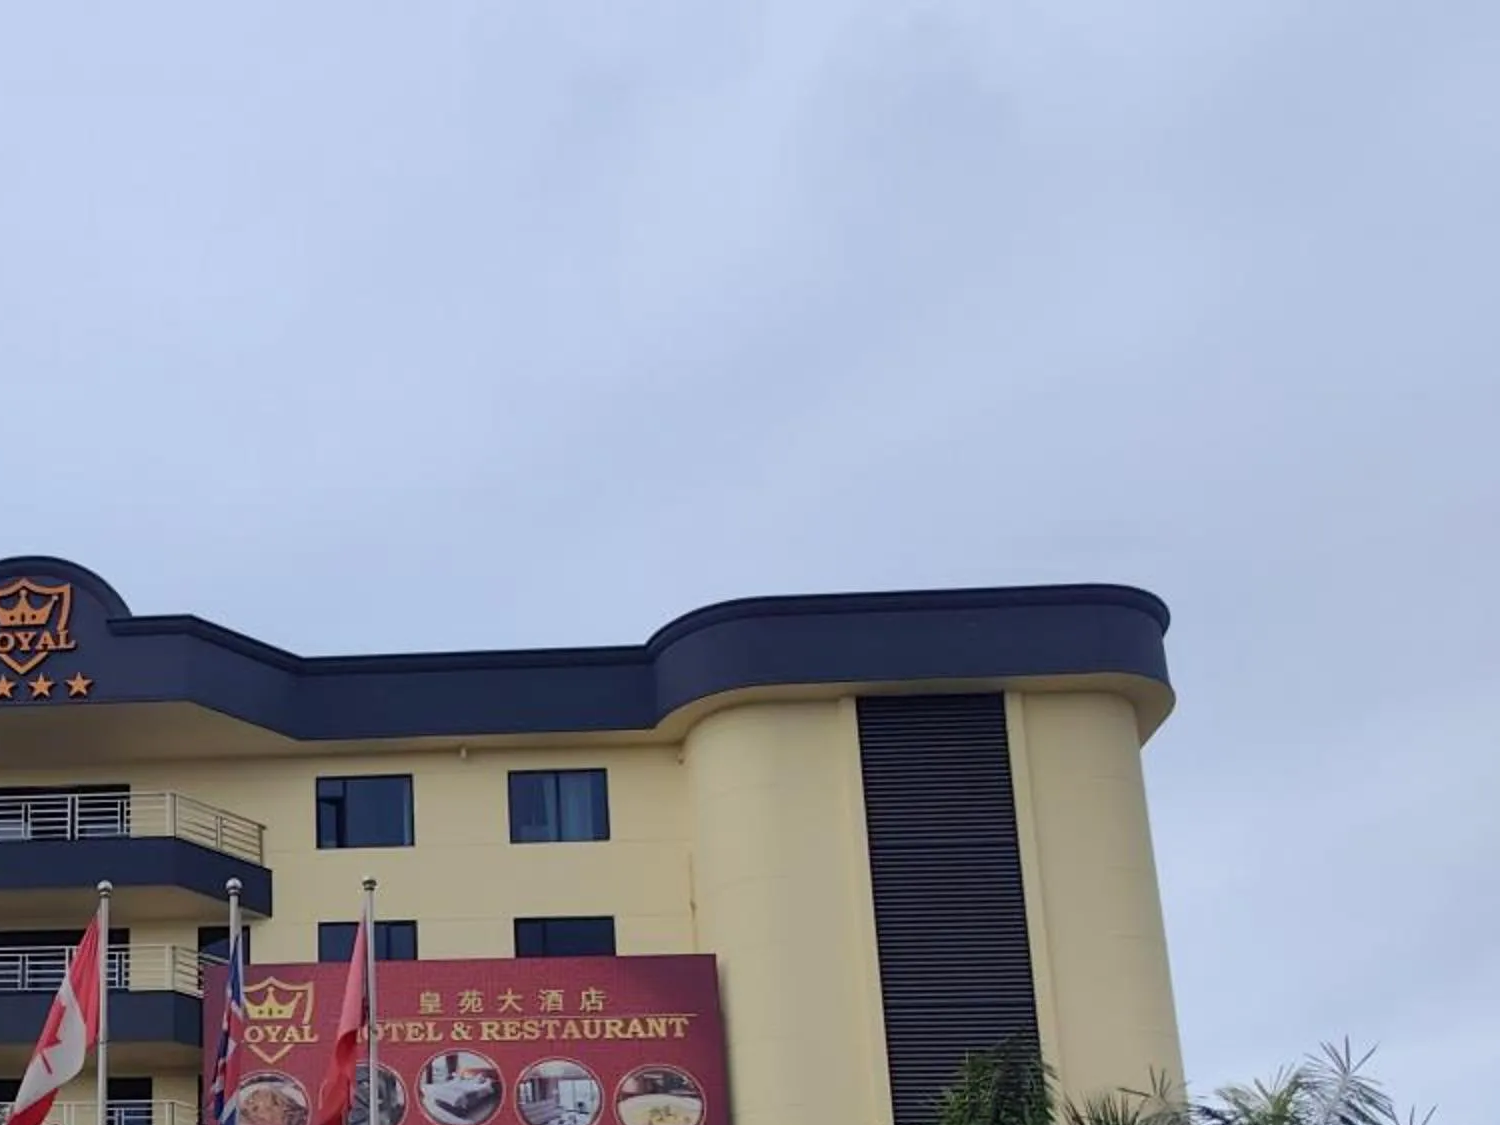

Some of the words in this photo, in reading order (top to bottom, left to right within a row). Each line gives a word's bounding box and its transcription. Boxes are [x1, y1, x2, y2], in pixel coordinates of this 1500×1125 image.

[419, 986, 606, 1015] 皇苑大酒店
[243, 1024, 319, 1043] OYAL
[356, 1021, 444, 1043] OTEL
[450, 1020, 473, 1041] &
[479, 1016, 689, 1042] RESTAURANT
